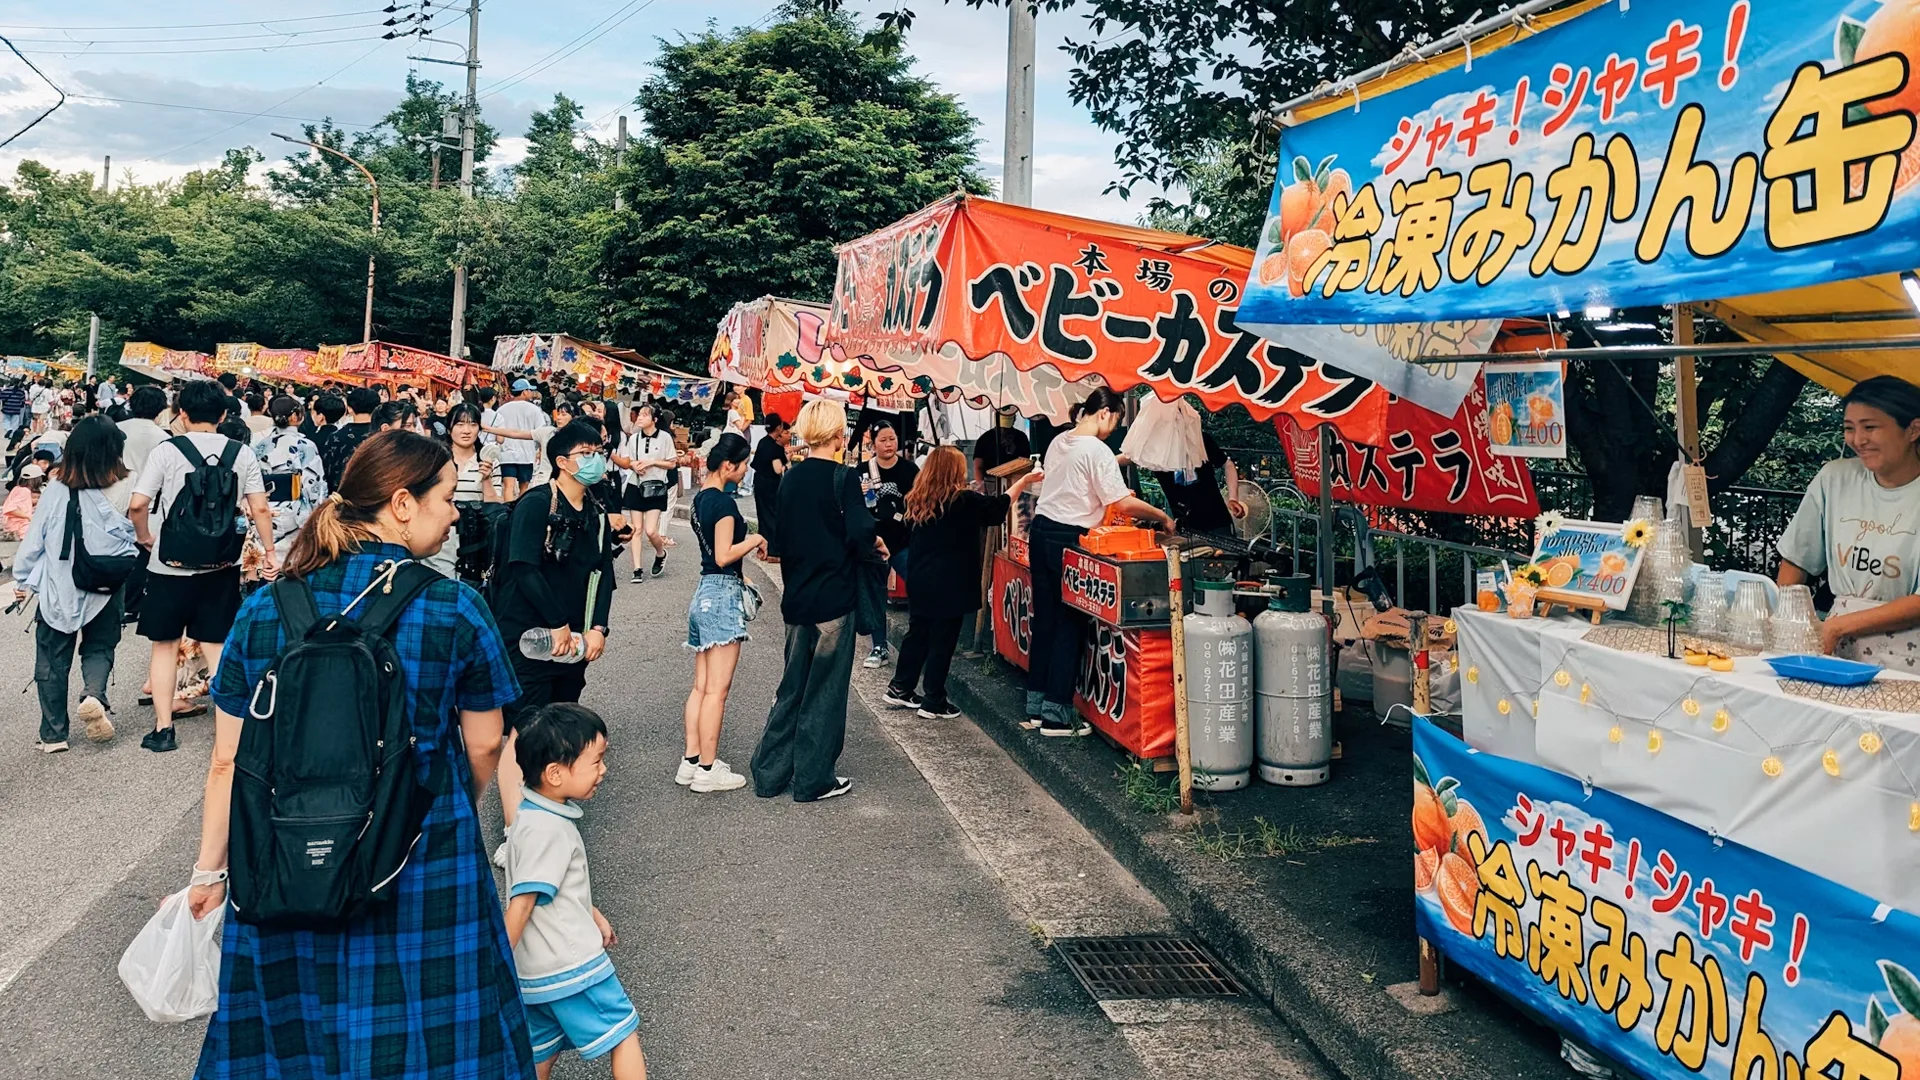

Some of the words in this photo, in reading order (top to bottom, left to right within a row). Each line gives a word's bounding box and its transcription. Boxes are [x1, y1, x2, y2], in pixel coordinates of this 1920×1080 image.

[1302, 51, 1917, 300] 冷凍みかん缶
[1546, 532, 1600, 549] orange
[1840, 513, 1917, 541] good
[1064, 564, 1116, 609] ベビーカステラ
[1003, 577, 1034, 656] ベビ
